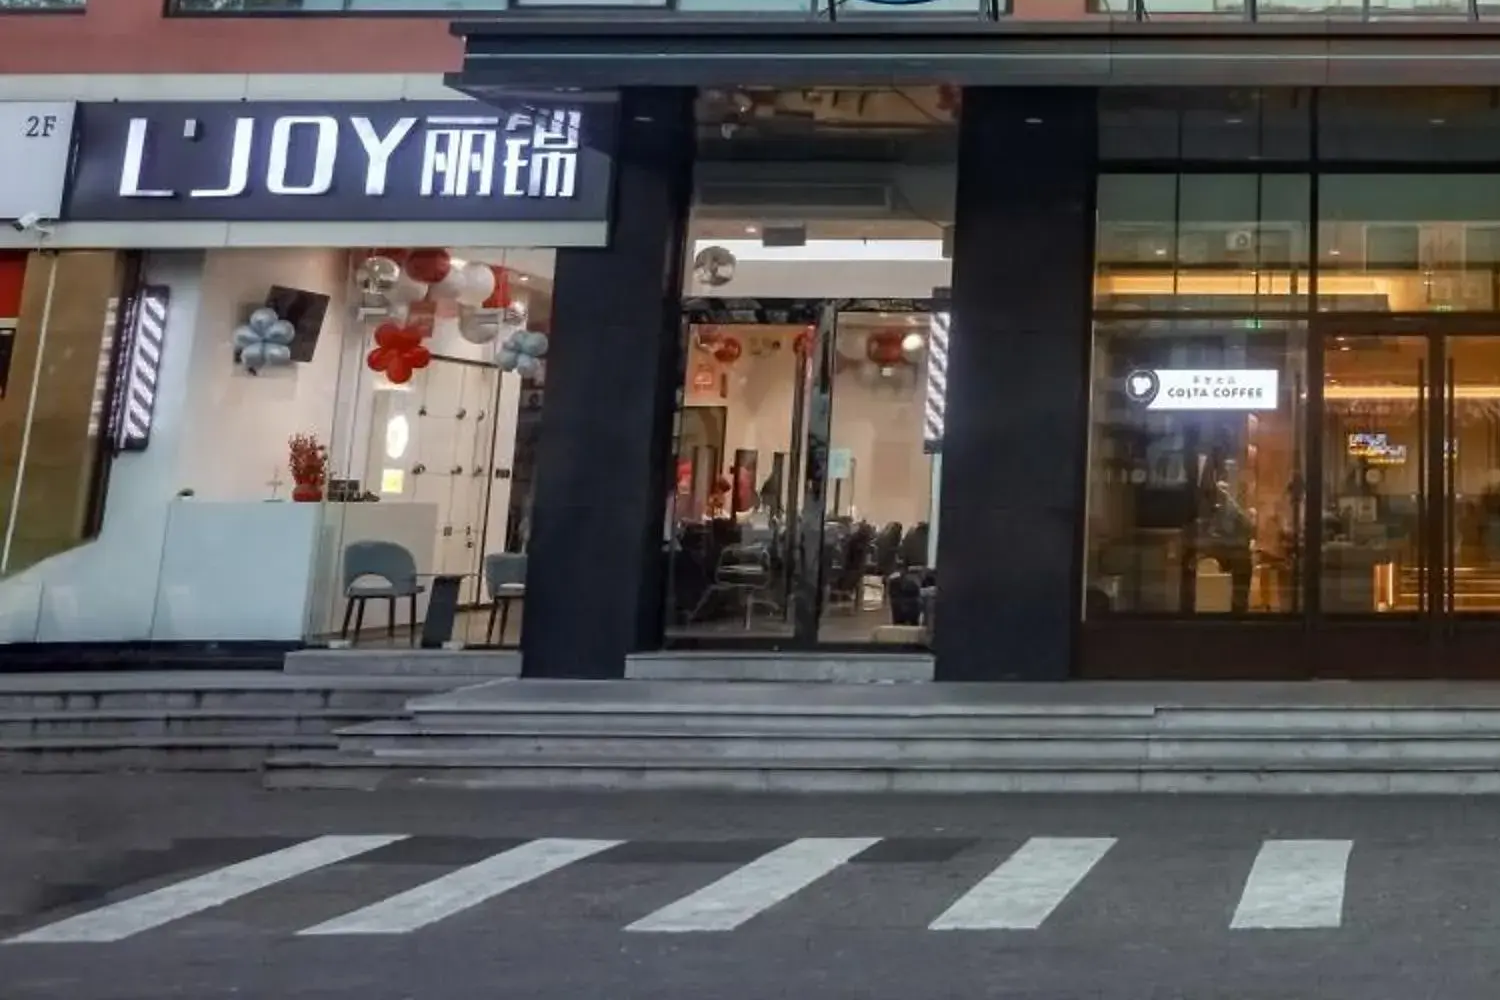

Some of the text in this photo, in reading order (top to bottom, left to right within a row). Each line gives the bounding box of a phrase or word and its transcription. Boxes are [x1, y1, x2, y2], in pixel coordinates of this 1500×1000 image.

[25, 115, 57, 137] 2F
[1167, 386, 1263, 400] COSTA COFFEE
